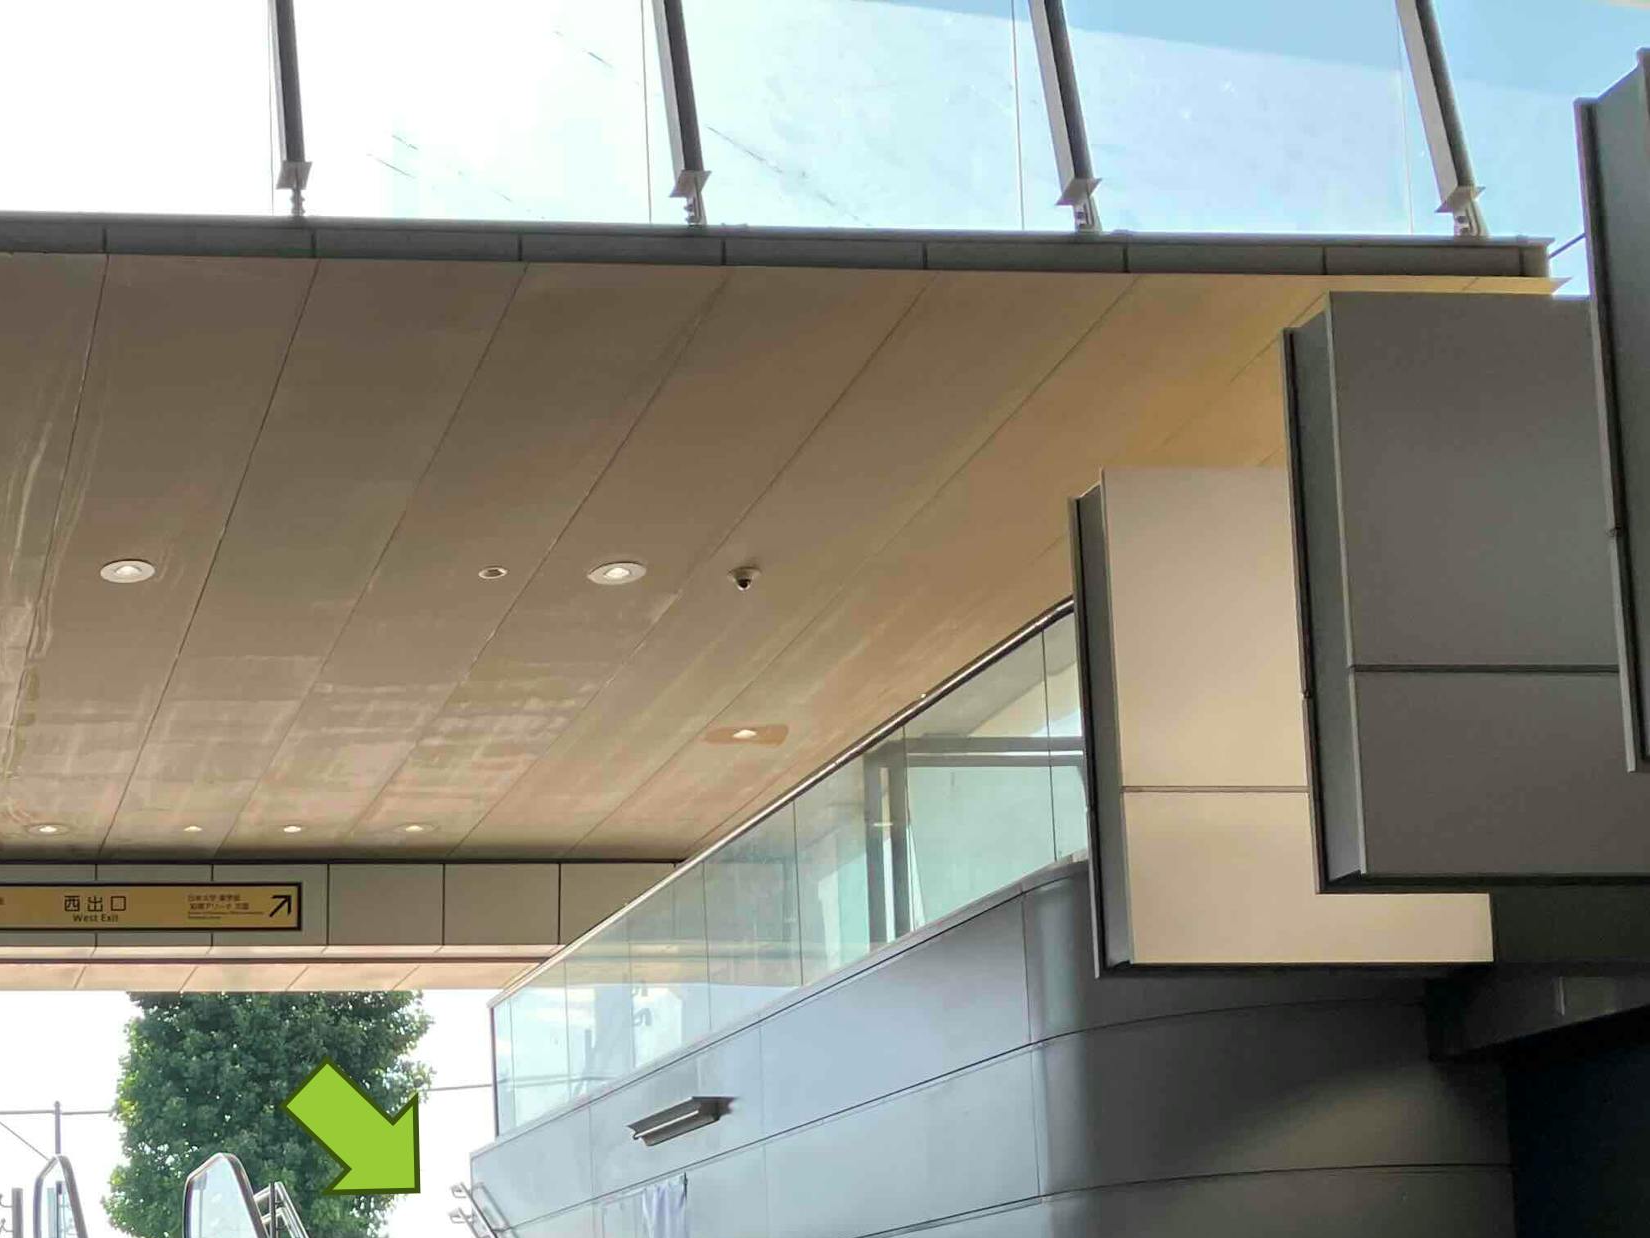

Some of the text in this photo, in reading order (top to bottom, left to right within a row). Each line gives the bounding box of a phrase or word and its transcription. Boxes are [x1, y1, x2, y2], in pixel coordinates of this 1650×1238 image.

[64, 895, 126, 912] 西出口
[72, 913, 118, 922] West Exit
